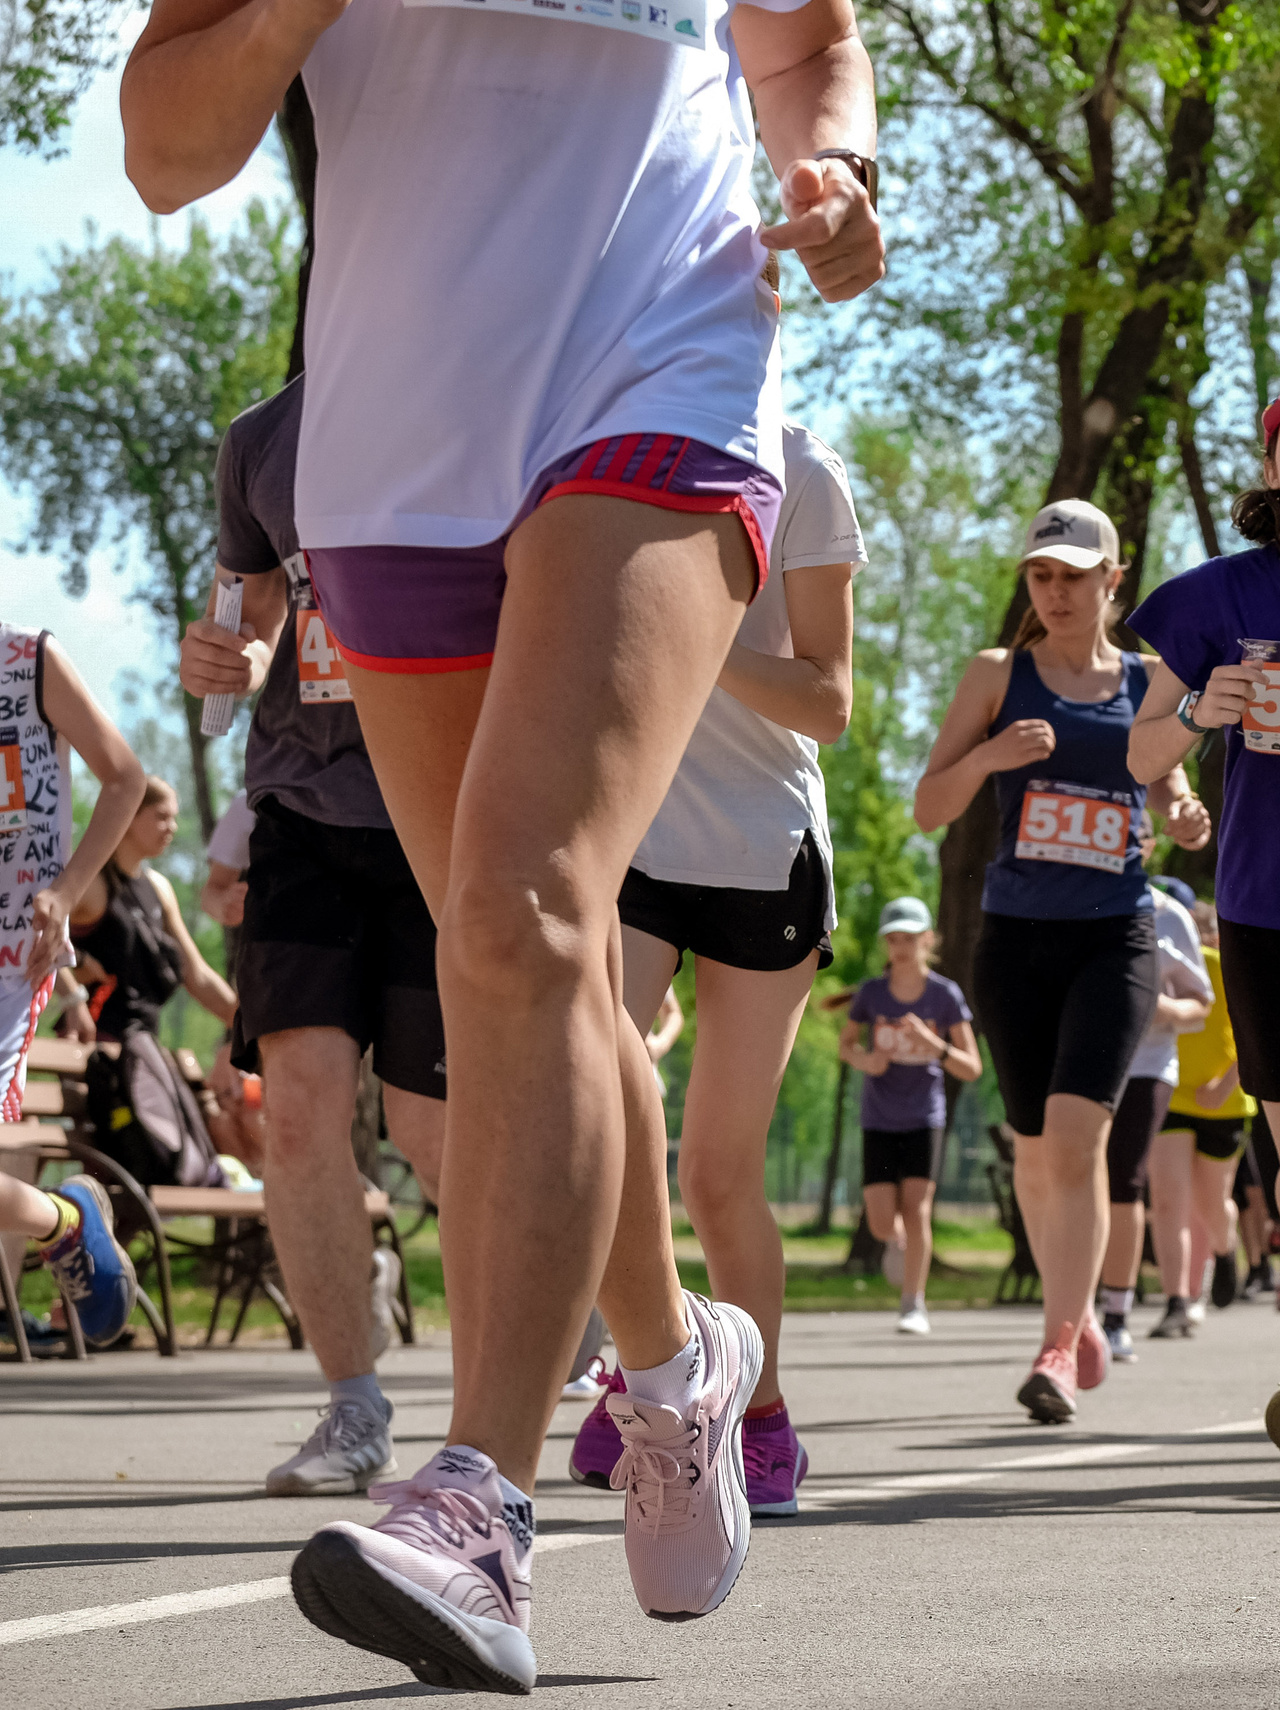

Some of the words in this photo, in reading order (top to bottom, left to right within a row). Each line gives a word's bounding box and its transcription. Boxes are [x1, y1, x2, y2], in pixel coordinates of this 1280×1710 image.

[301, 616, 342, 675] 4
[1025, 796, 1124, 851] 518
[440, 1449, 487, 1470] Reebok
